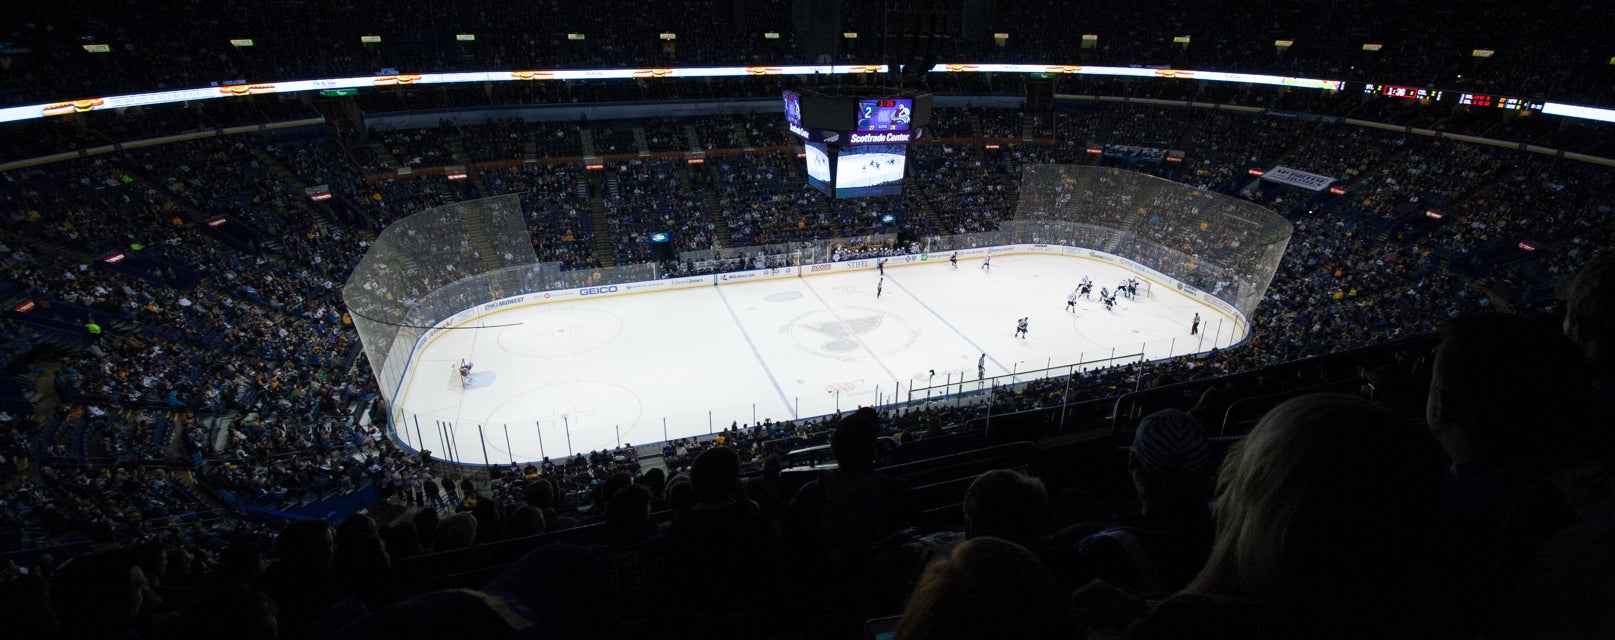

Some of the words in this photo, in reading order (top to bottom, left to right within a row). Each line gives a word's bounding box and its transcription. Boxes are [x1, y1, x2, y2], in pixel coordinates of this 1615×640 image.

[864, 106, 872, 119] 2
[851, 133, 886, 143] Scottrade
[886, 132, 910, 142] Center
[580, 285, 618, 296] GEICO
[499, 297, 524, 307] MIDWEST
